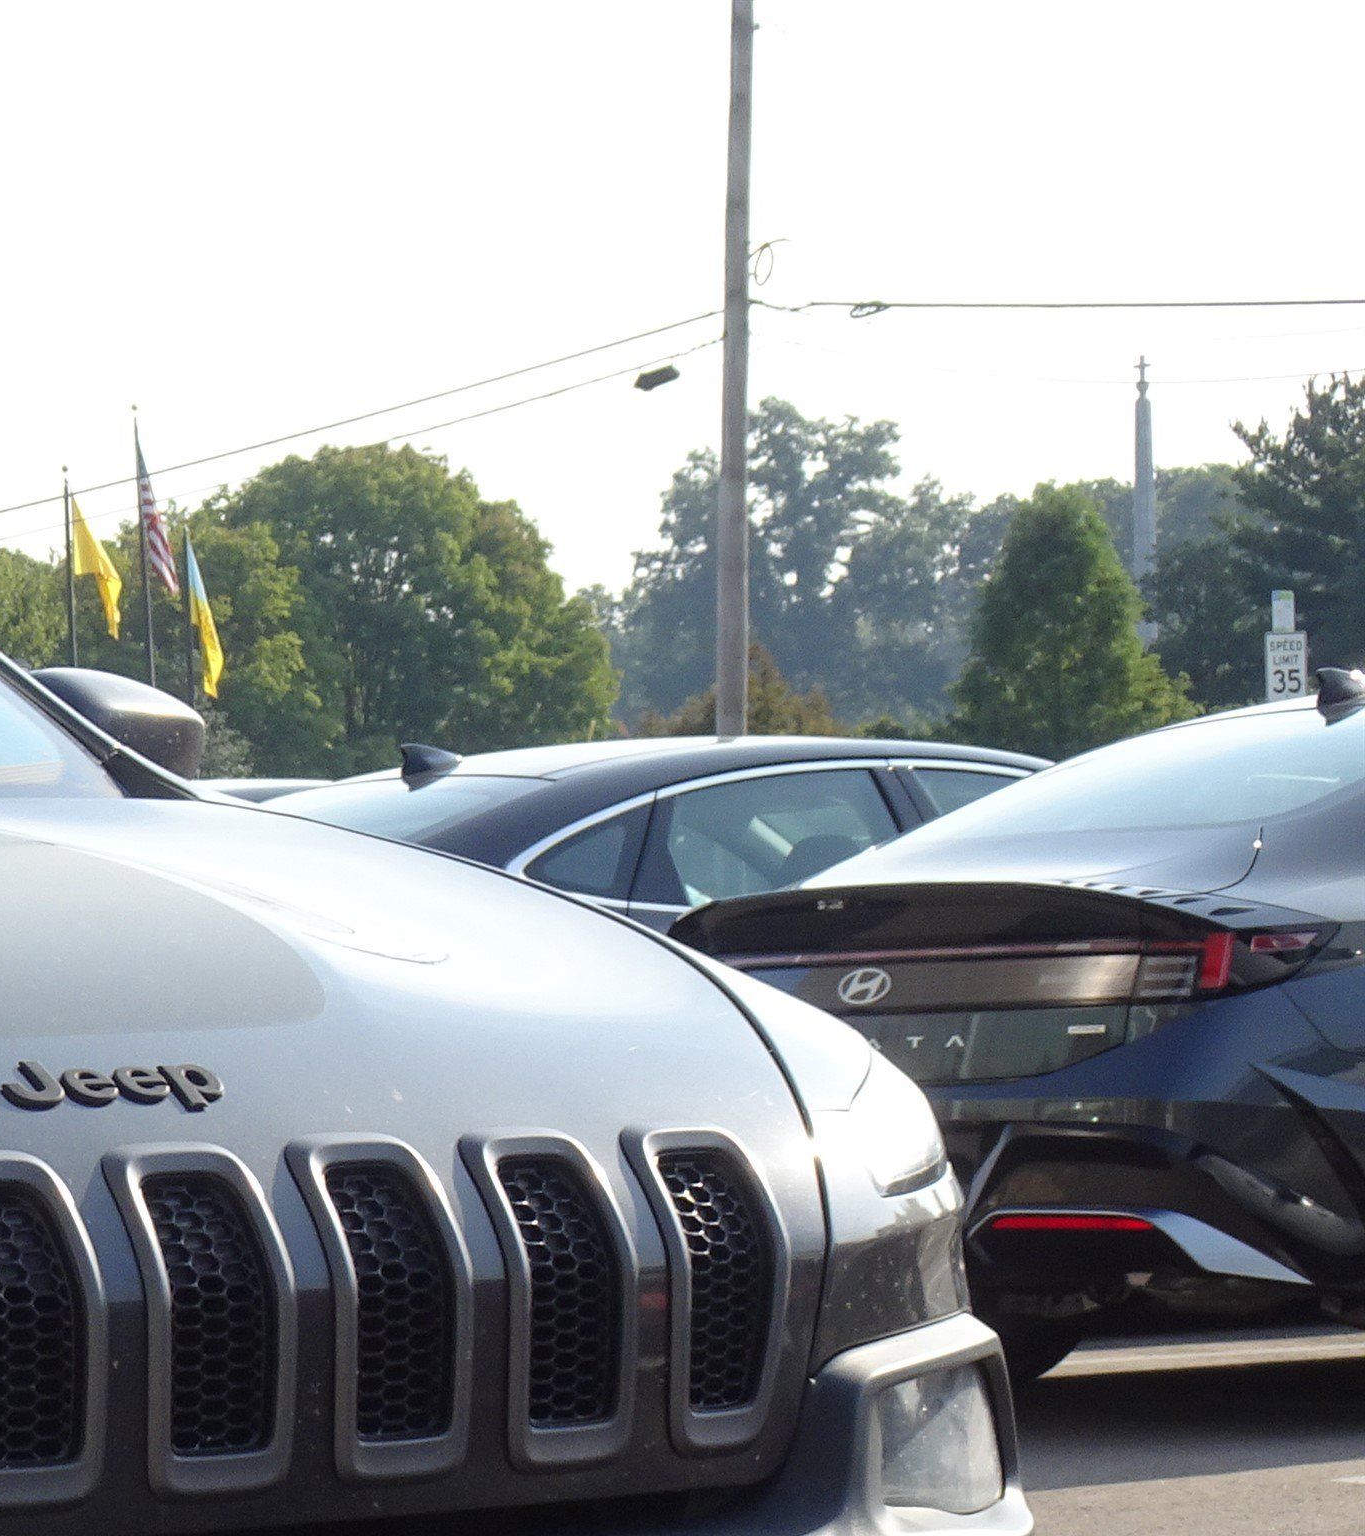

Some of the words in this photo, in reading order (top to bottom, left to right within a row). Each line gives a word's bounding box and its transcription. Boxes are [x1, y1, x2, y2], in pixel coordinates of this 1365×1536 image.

[1269, 641, 1303, 652] SPEED
[1272, 655, 1299, 666] LIMIT
[1272, 669, 1302, 693] 35
[0, 1060, 225, 1112] Jeep
